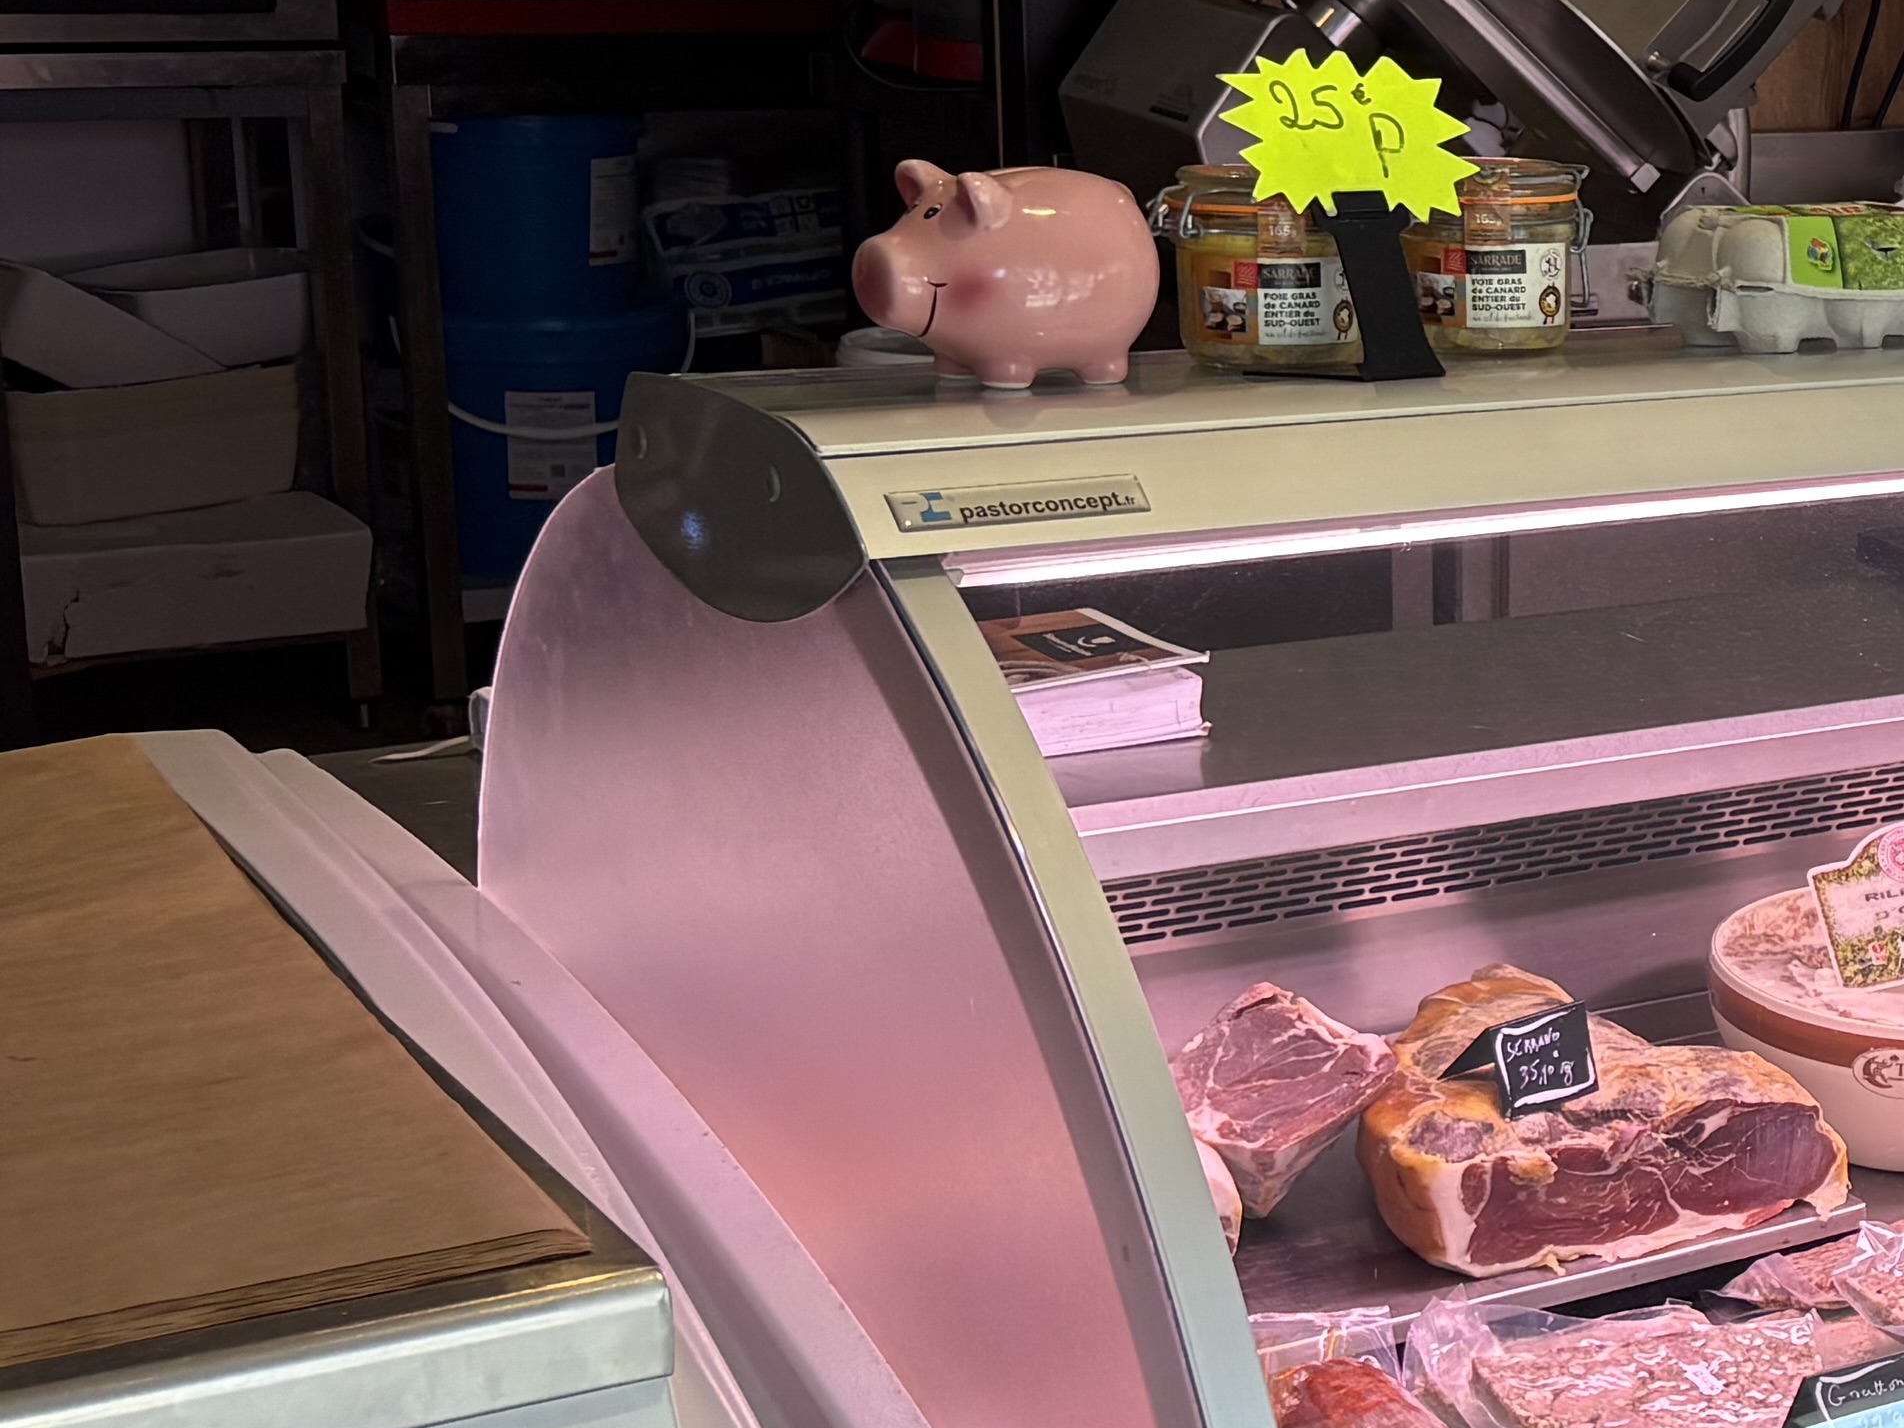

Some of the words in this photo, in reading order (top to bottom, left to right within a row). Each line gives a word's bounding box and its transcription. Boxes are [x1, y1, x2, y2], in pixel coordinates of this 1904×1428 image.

[1471, 278, 1494, 286] FOIE
[1497, 278, 1523, 286] GRAS
[1485, 286, 1526, 294] CANARD
[1263, 292, 1288, 301] FOIE
[1291, 292, 1317, 301] GRAS
[1471, 295, 1507, 303] ENTIER
[1279, 300, 1321, 310] CANARD
[1471, 303, 1526, 311] SUD-OUEST
[1264, 310, 1301, 318] ENTIER
[1263, 318, 1320, 327] SUD-OUEST
[959, 490, 1137, 523] pastorconcept.fr
